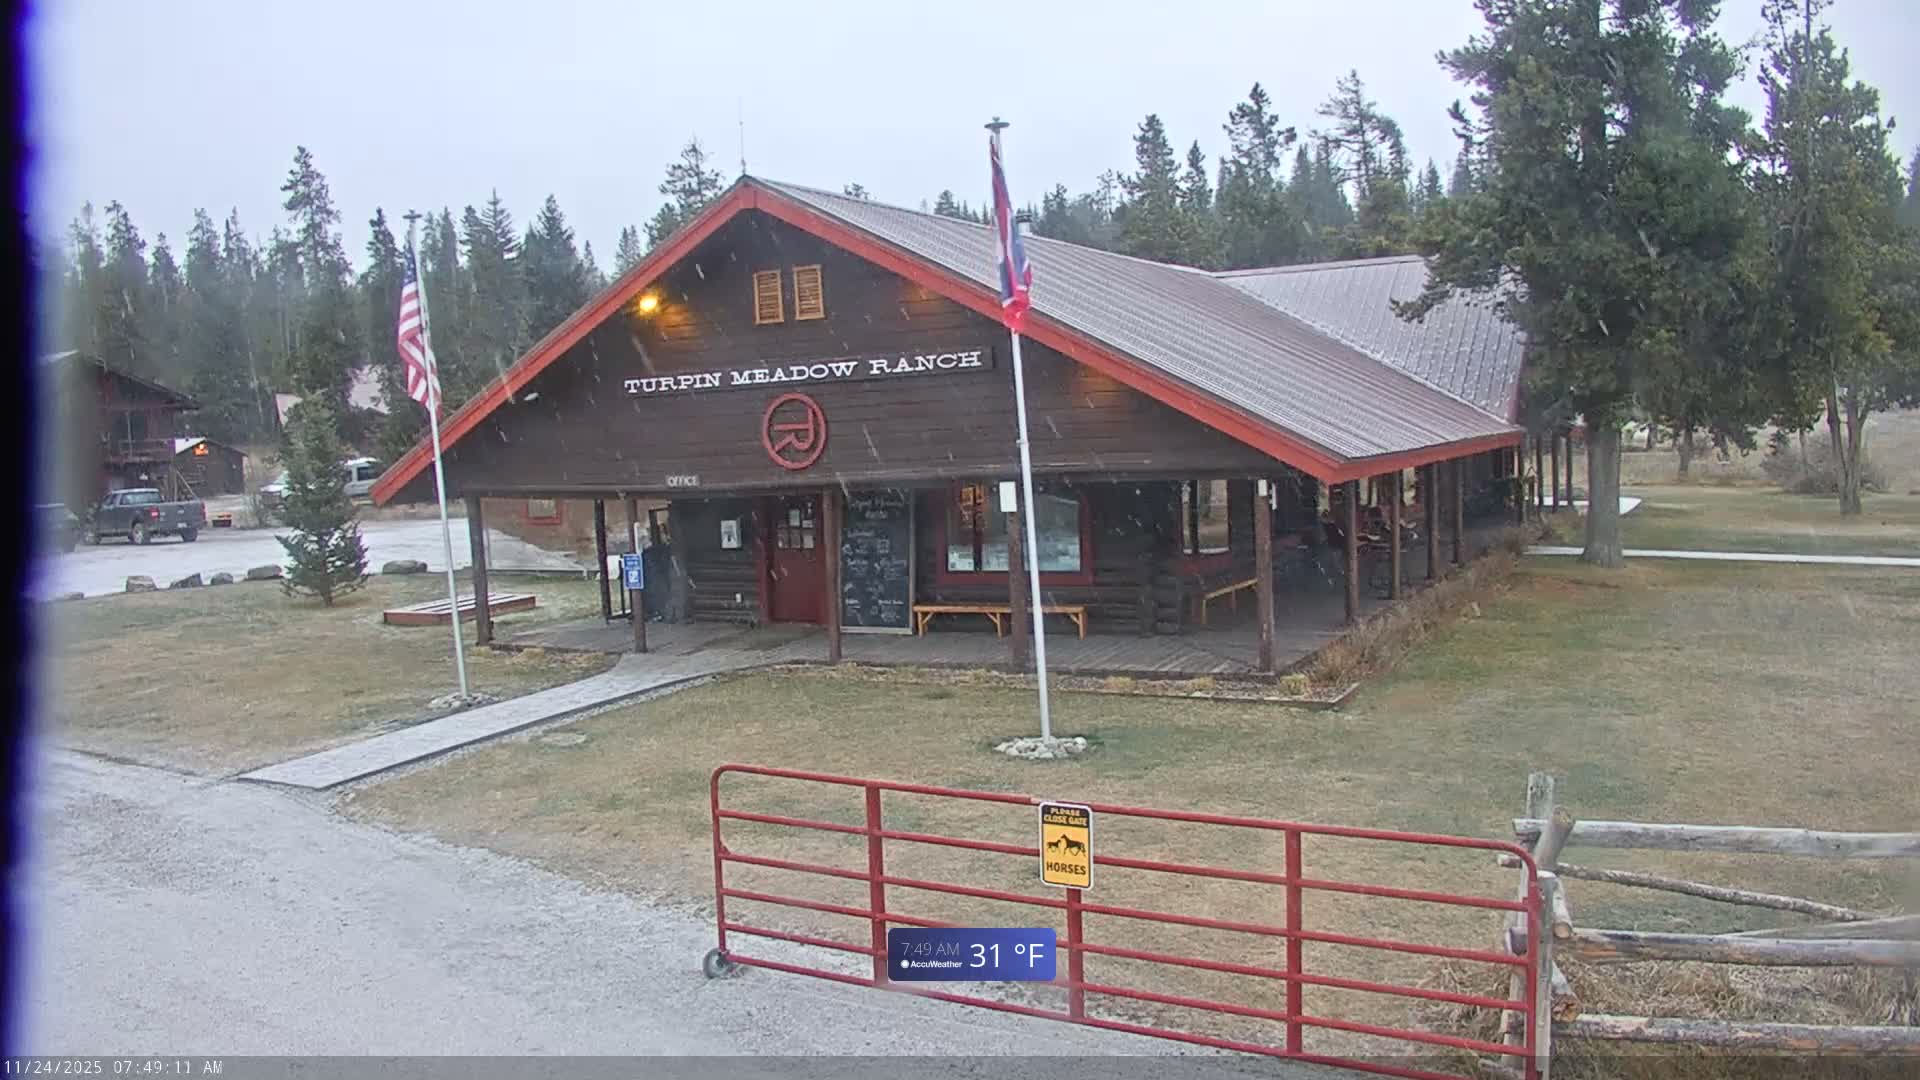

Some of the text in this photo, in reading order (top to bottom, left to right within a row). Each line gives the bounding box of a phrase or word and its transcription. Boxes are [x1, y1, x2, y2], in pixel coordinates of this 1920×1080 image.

[624, 350, 983, 394] TURPIN MEADOW RANCH
[1050, 807, 1081, 817] PLEASE
[1043, 813, 1088, 826] CLOSE GATE
[1046, 861, 1087, 876] HORSES
